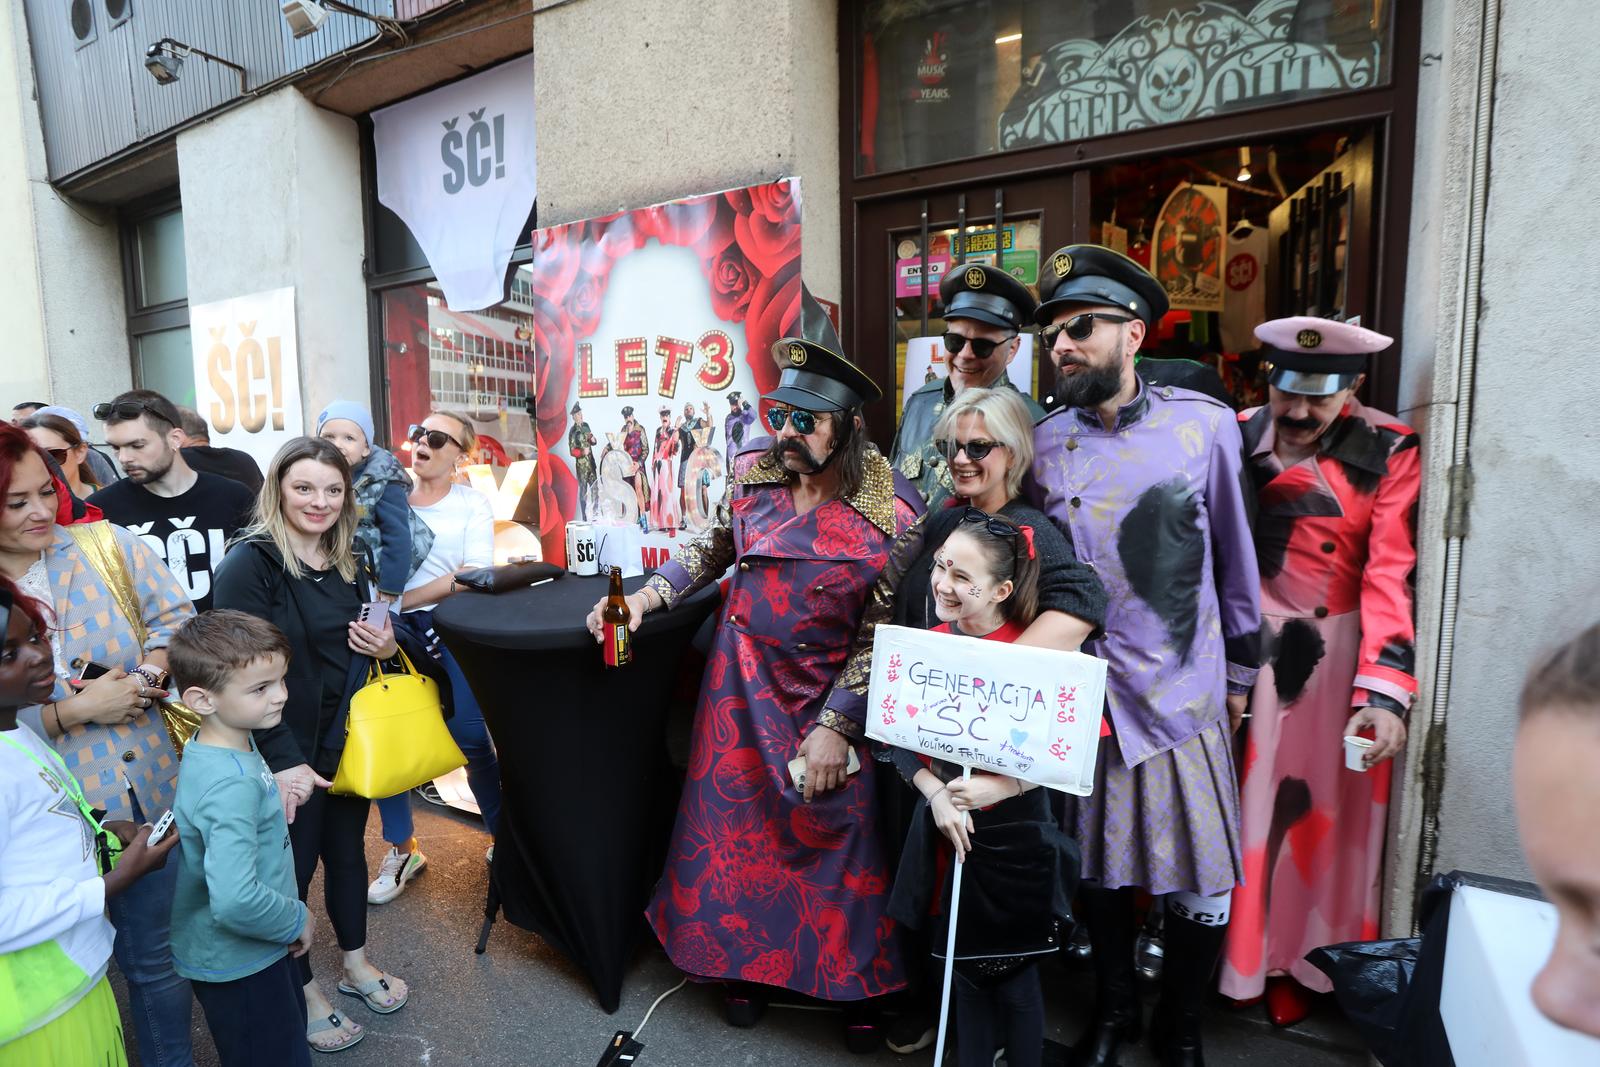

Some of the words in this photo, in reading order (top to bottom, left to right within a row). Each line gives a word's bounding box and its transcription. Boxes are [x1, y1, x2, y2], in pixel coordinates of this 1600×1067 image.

[917, 64, 947, 76] MUSIC
[1037, 90, 1134, 142] KEEP
[1215, 53, 1327, 104] OUT
[441, 106, 505, 195] ŠČ!
[207, 319, 285, 434] ŠČ!
[918, 692, 990, 741] ŠČ
